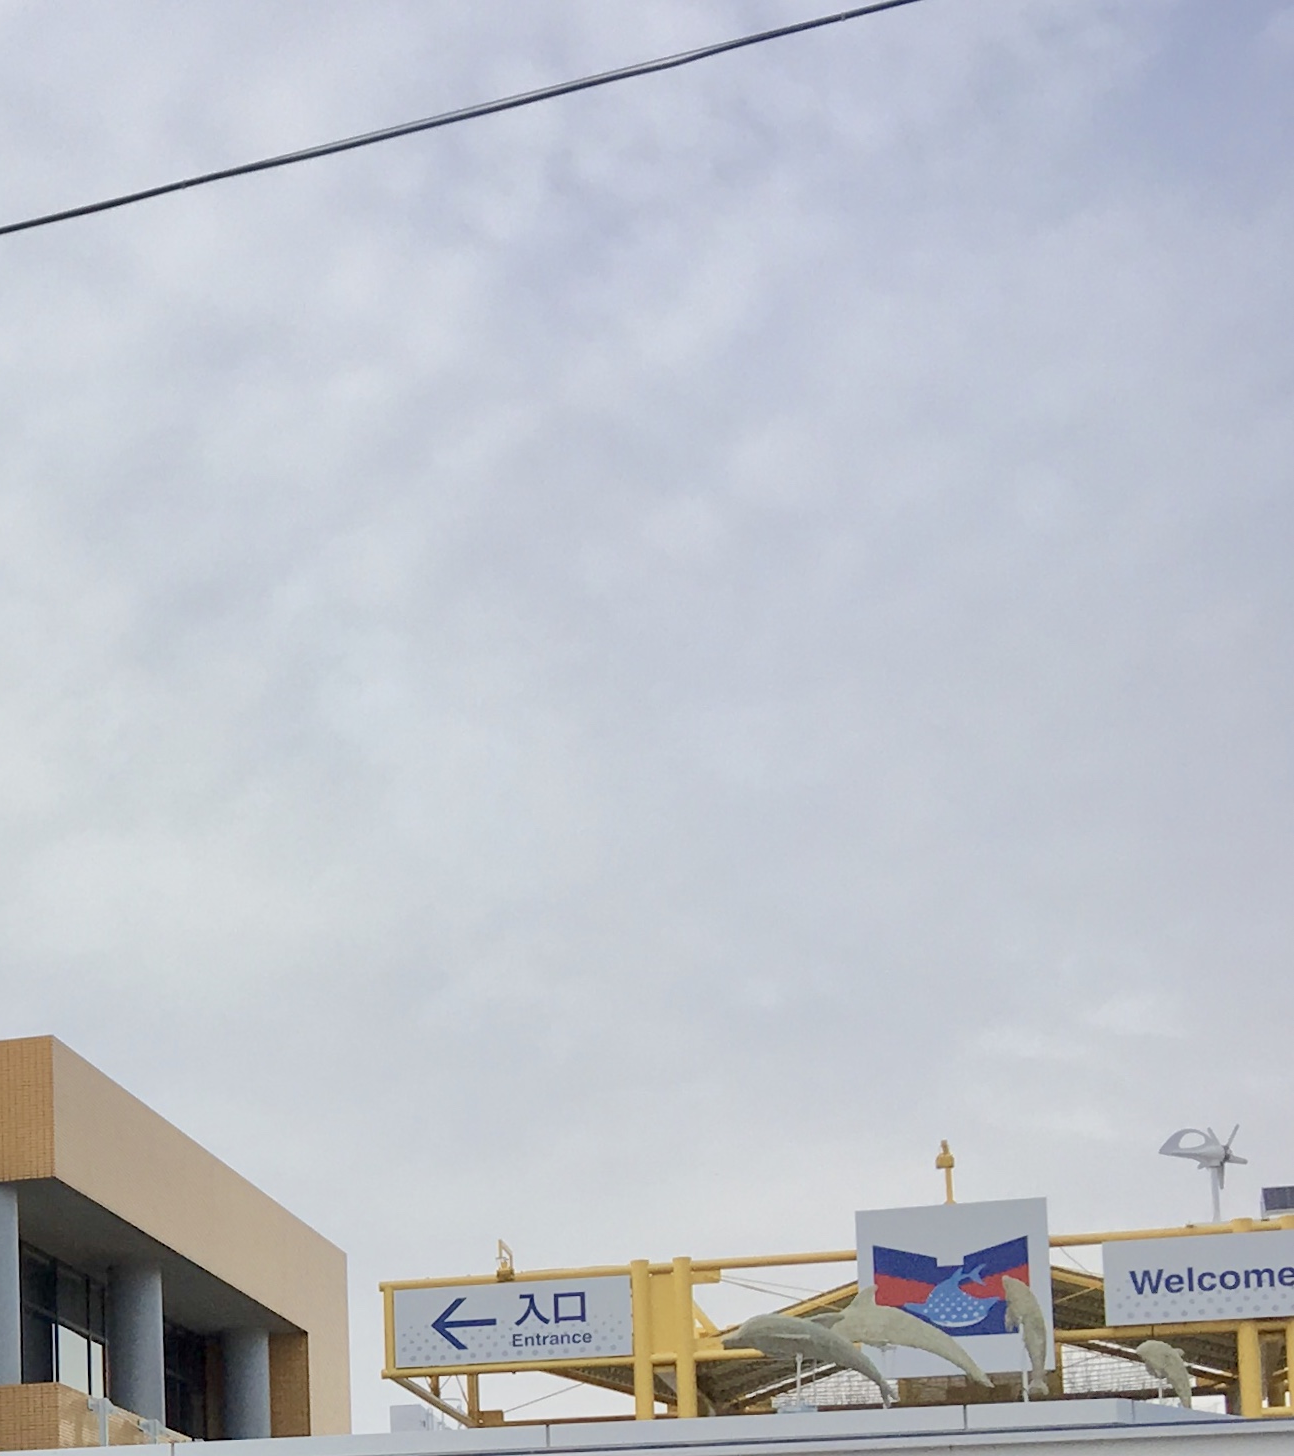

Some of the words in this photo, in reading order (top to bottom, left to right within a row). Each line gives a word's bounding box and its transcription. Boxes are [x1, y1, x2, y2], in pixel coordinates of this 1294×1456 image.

[1129, 1266, 1294, 1296] Welcome
[514, 1291, 587, 1326] 入口
[511, 1332, 593, 1347] Entrance
